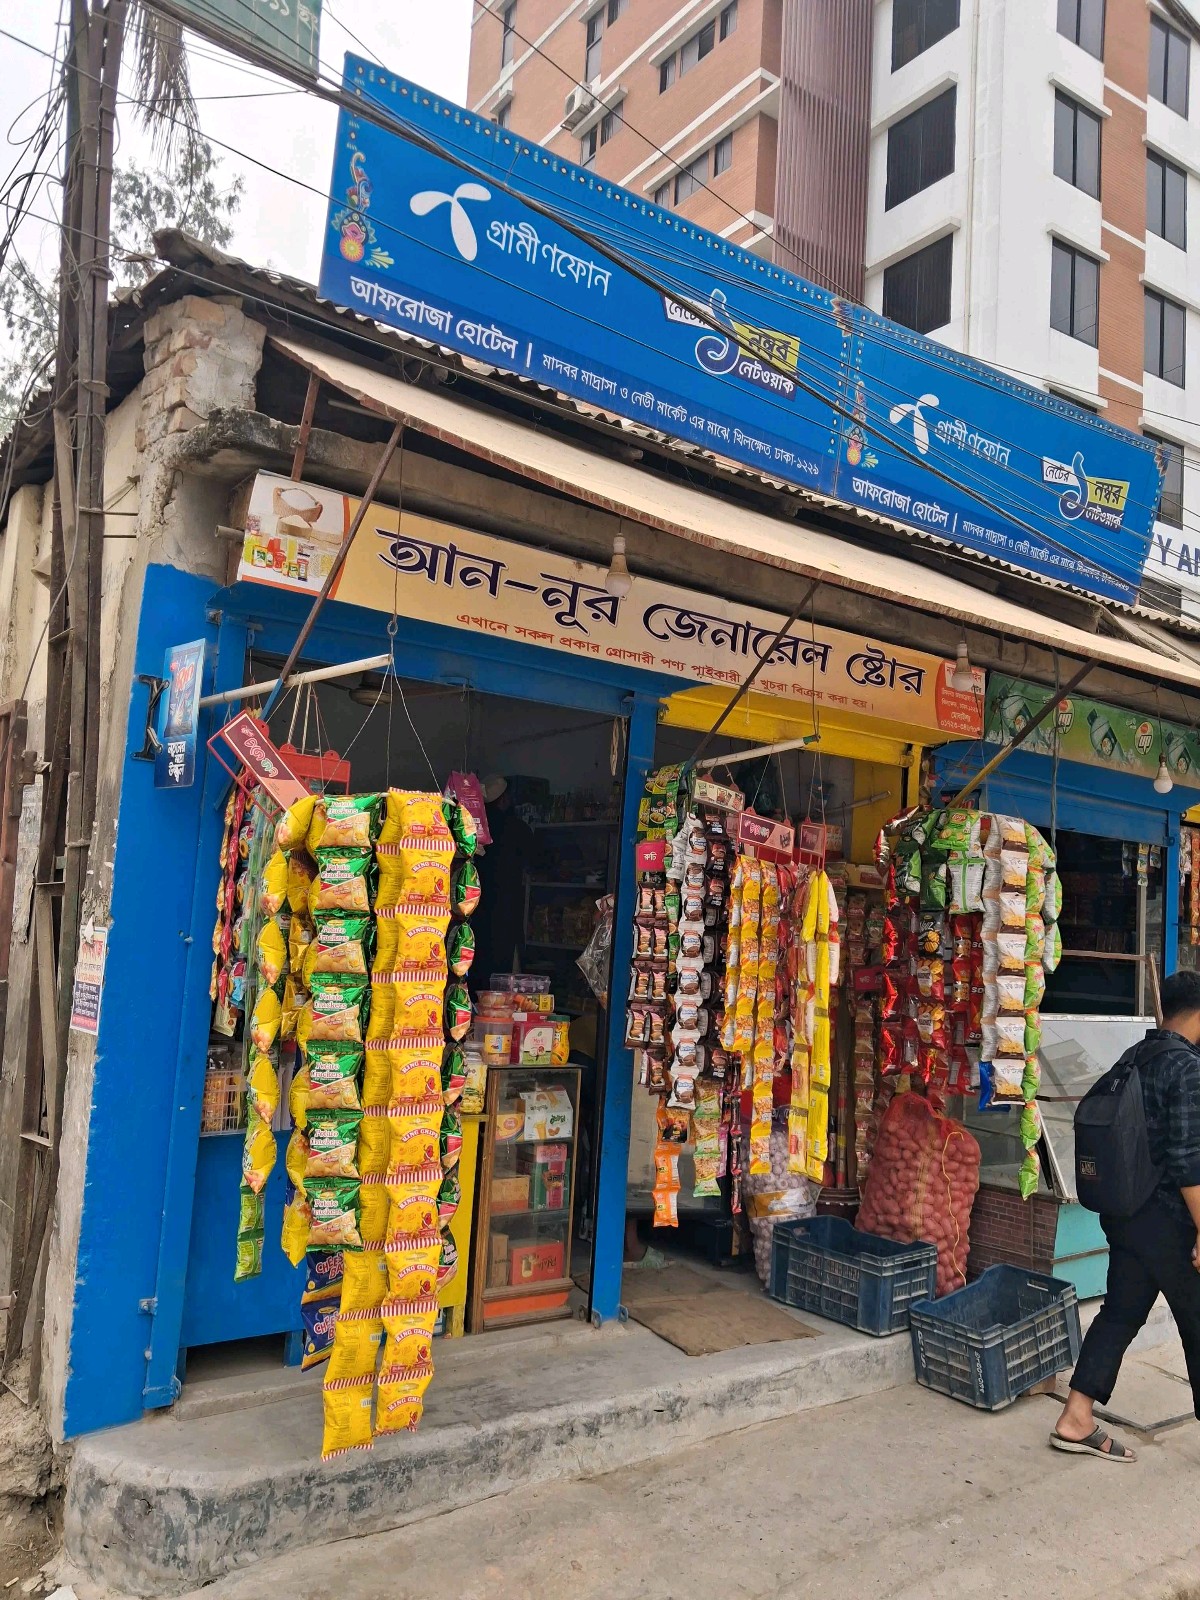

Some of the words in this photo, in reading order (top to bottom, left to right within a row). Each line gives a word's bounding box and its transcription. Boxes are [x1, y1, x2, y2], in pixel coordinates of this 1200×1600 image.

[487, 217, 612, 296] গ্রামীণফোন
[350, 276, 453, 334] আফরোজা
[456, 319, 518, 359] হোটেল
[543, 353, 578, 380] মাদবর
[581, 368, 618, 397] মাদ্রাসা
[620, 386, 628, 400] ও
[631, 390, 655, 412] নেভী
[657, 400, 688, 421] মার্কেট
[689, 412, 705, 431] এর
[935, 419, 1012, 470] গ্রামীণফোন
[852, 477, 912, 512] আফরোজা
[912, 503, 949, 528] হোটেল
[1045, 464, 1070, 483] নেটের
[1095, 481, 1124, 505] নম্বর
[375, 528, 626, 635] আন-নূর
[643, 602, 833, 676] জেনারেল
[456, 614, 509, 633] এখানে
[515, 626, 553, 644] সকল
[560, 637, 600, 654] প্রকার
[661, 658, 686, 672] পণ্য
[760, 678, 788, 692] খুচরা
[792, 683, 824, 700] বিক্রয়
[828, 691, 848, 705] করা
